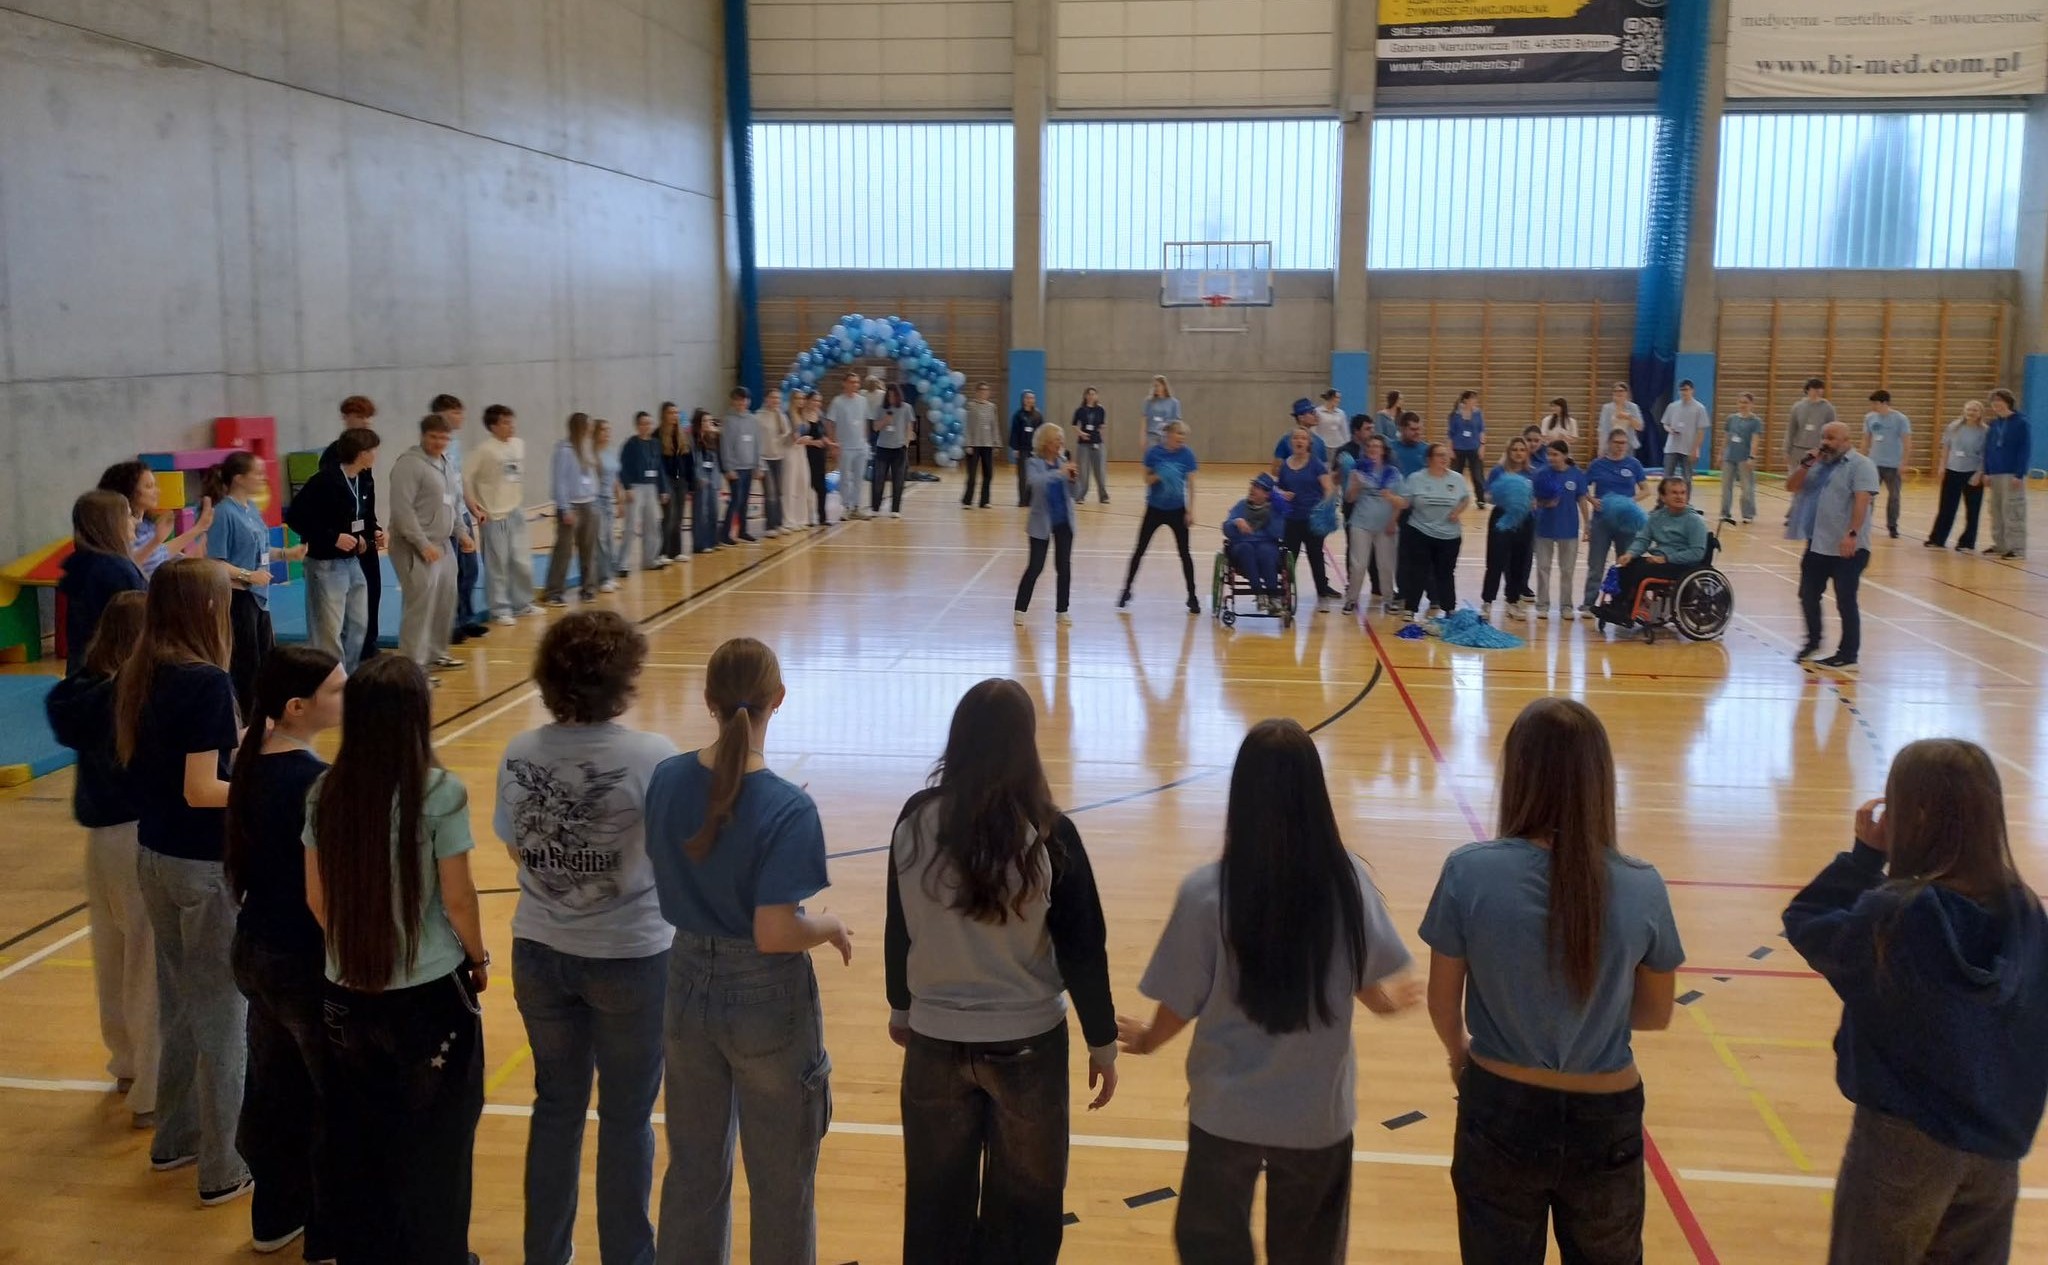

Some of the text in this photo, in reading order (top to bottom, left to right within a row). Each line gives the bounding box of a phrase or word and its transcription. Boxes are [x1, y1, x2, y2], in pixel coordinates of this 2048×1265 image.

[1741, 14, 1818, 30] medycyna
[1391, 25, 1496, 36] SKLEP STACJONARNY
[1439, 40, 1510, 52] Narutowicza
[1575, 38, 1610, 50] Bytom
[1755, 51, 2022, 78] www.bi-med.com.pl
